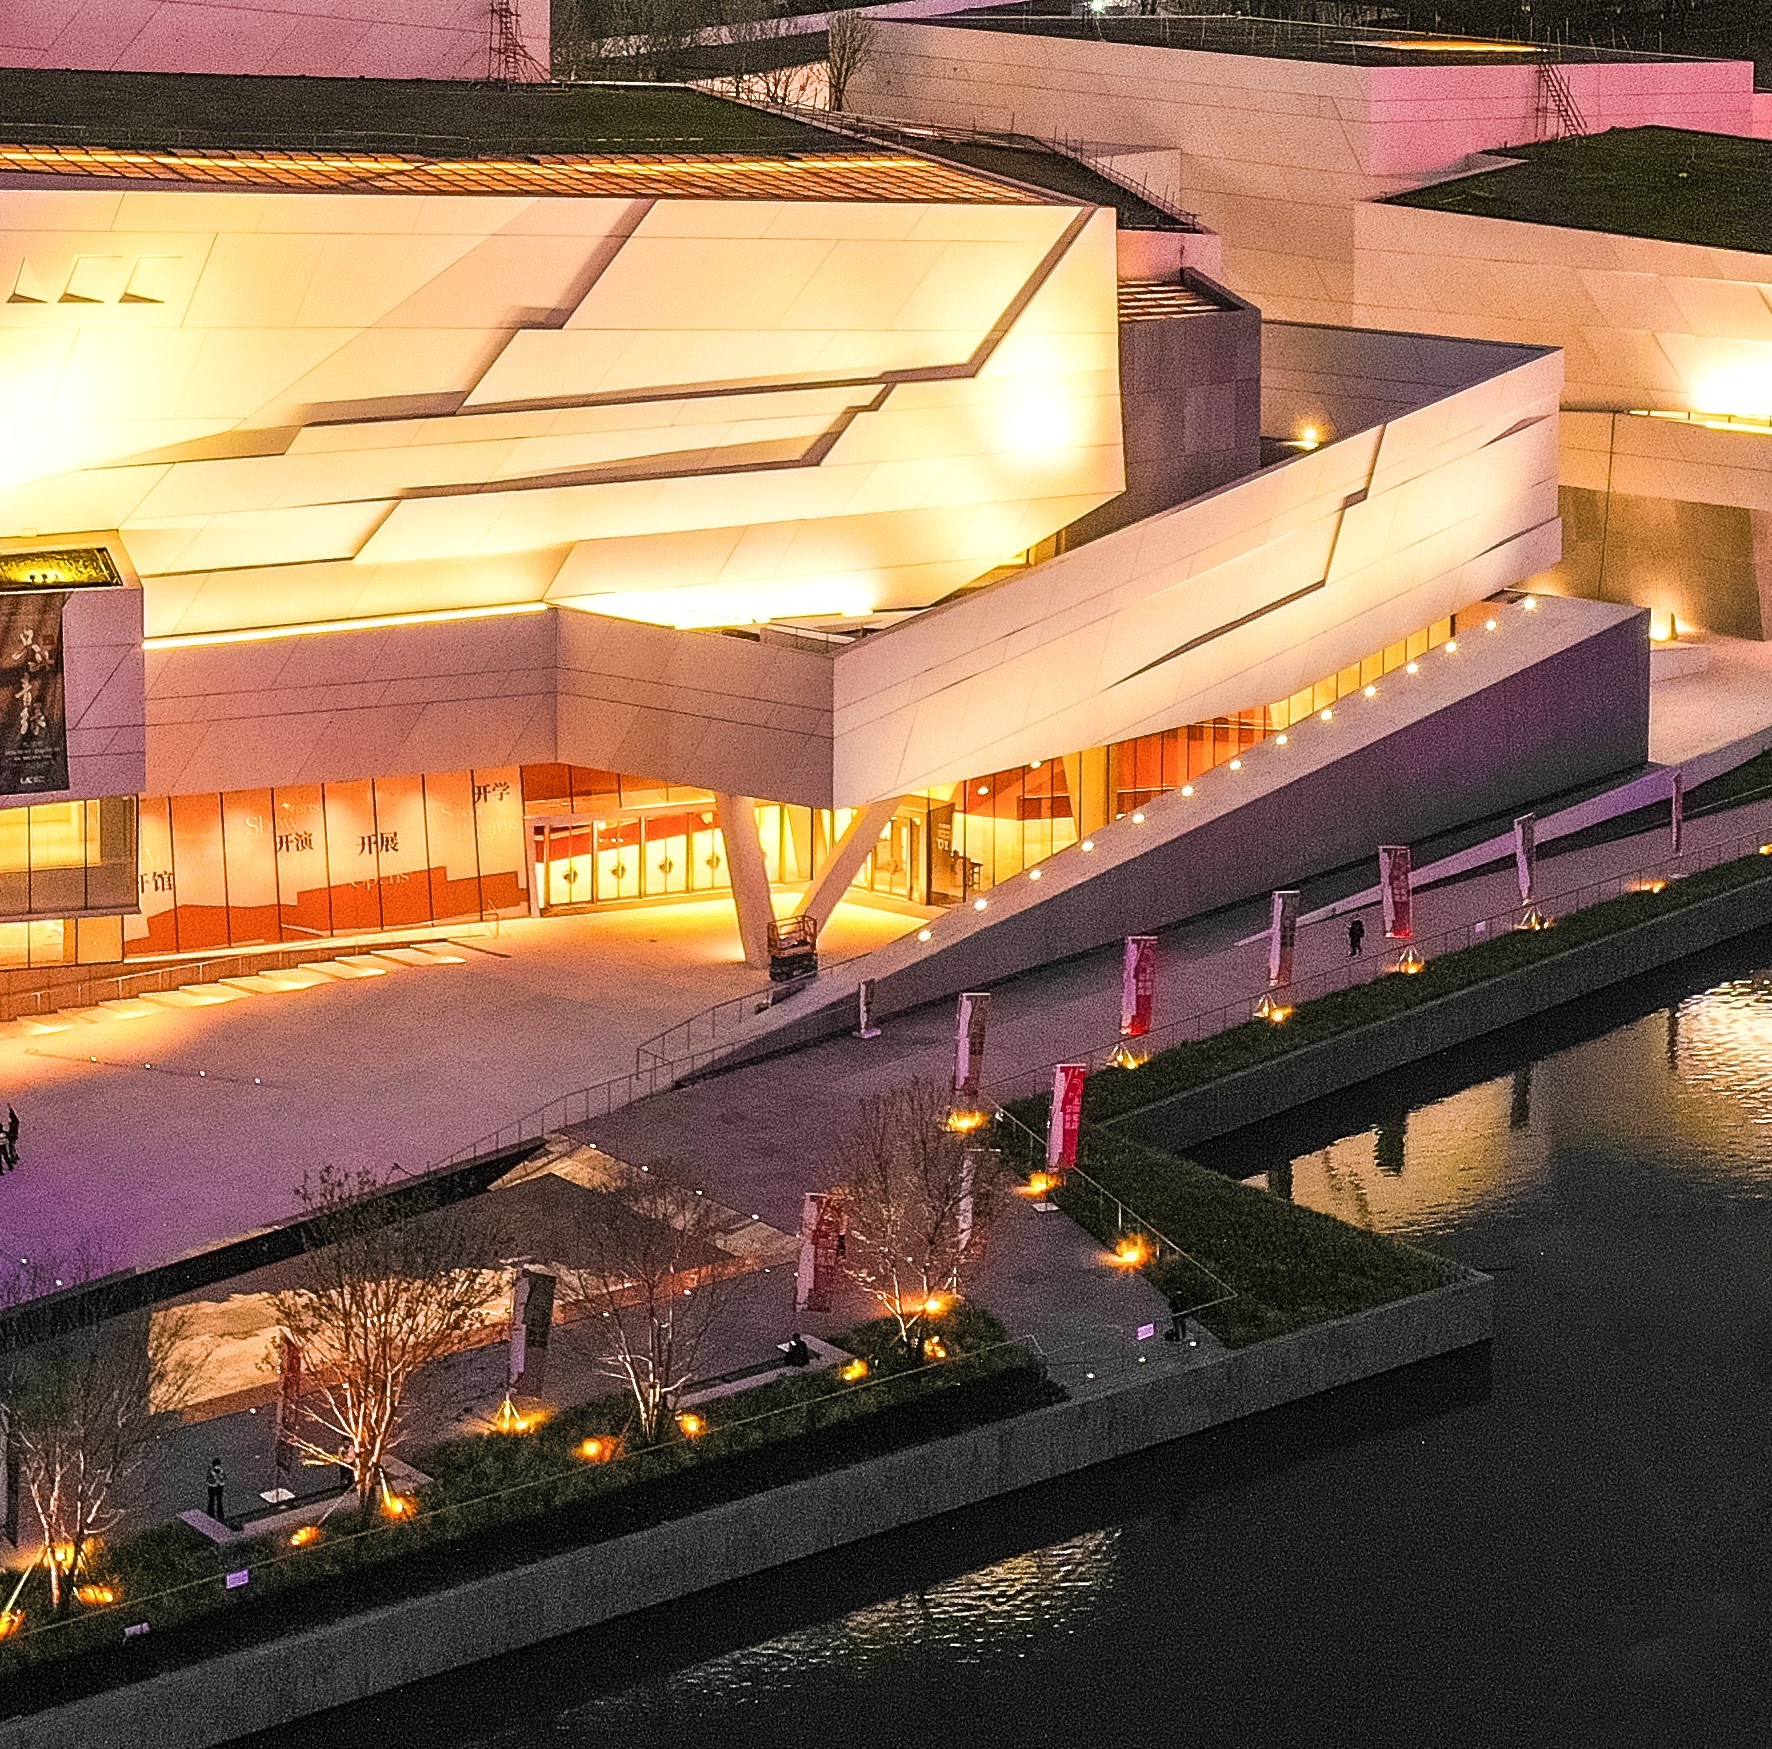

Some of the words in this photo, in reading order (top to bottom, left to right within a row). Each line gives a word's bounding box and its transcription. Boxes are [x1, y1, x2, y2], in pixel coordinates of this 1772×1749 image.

[475, 781, 511, 803] 开学
[276, 830, 315, 853] 开演
[357, 831, 400, 856] 开展
